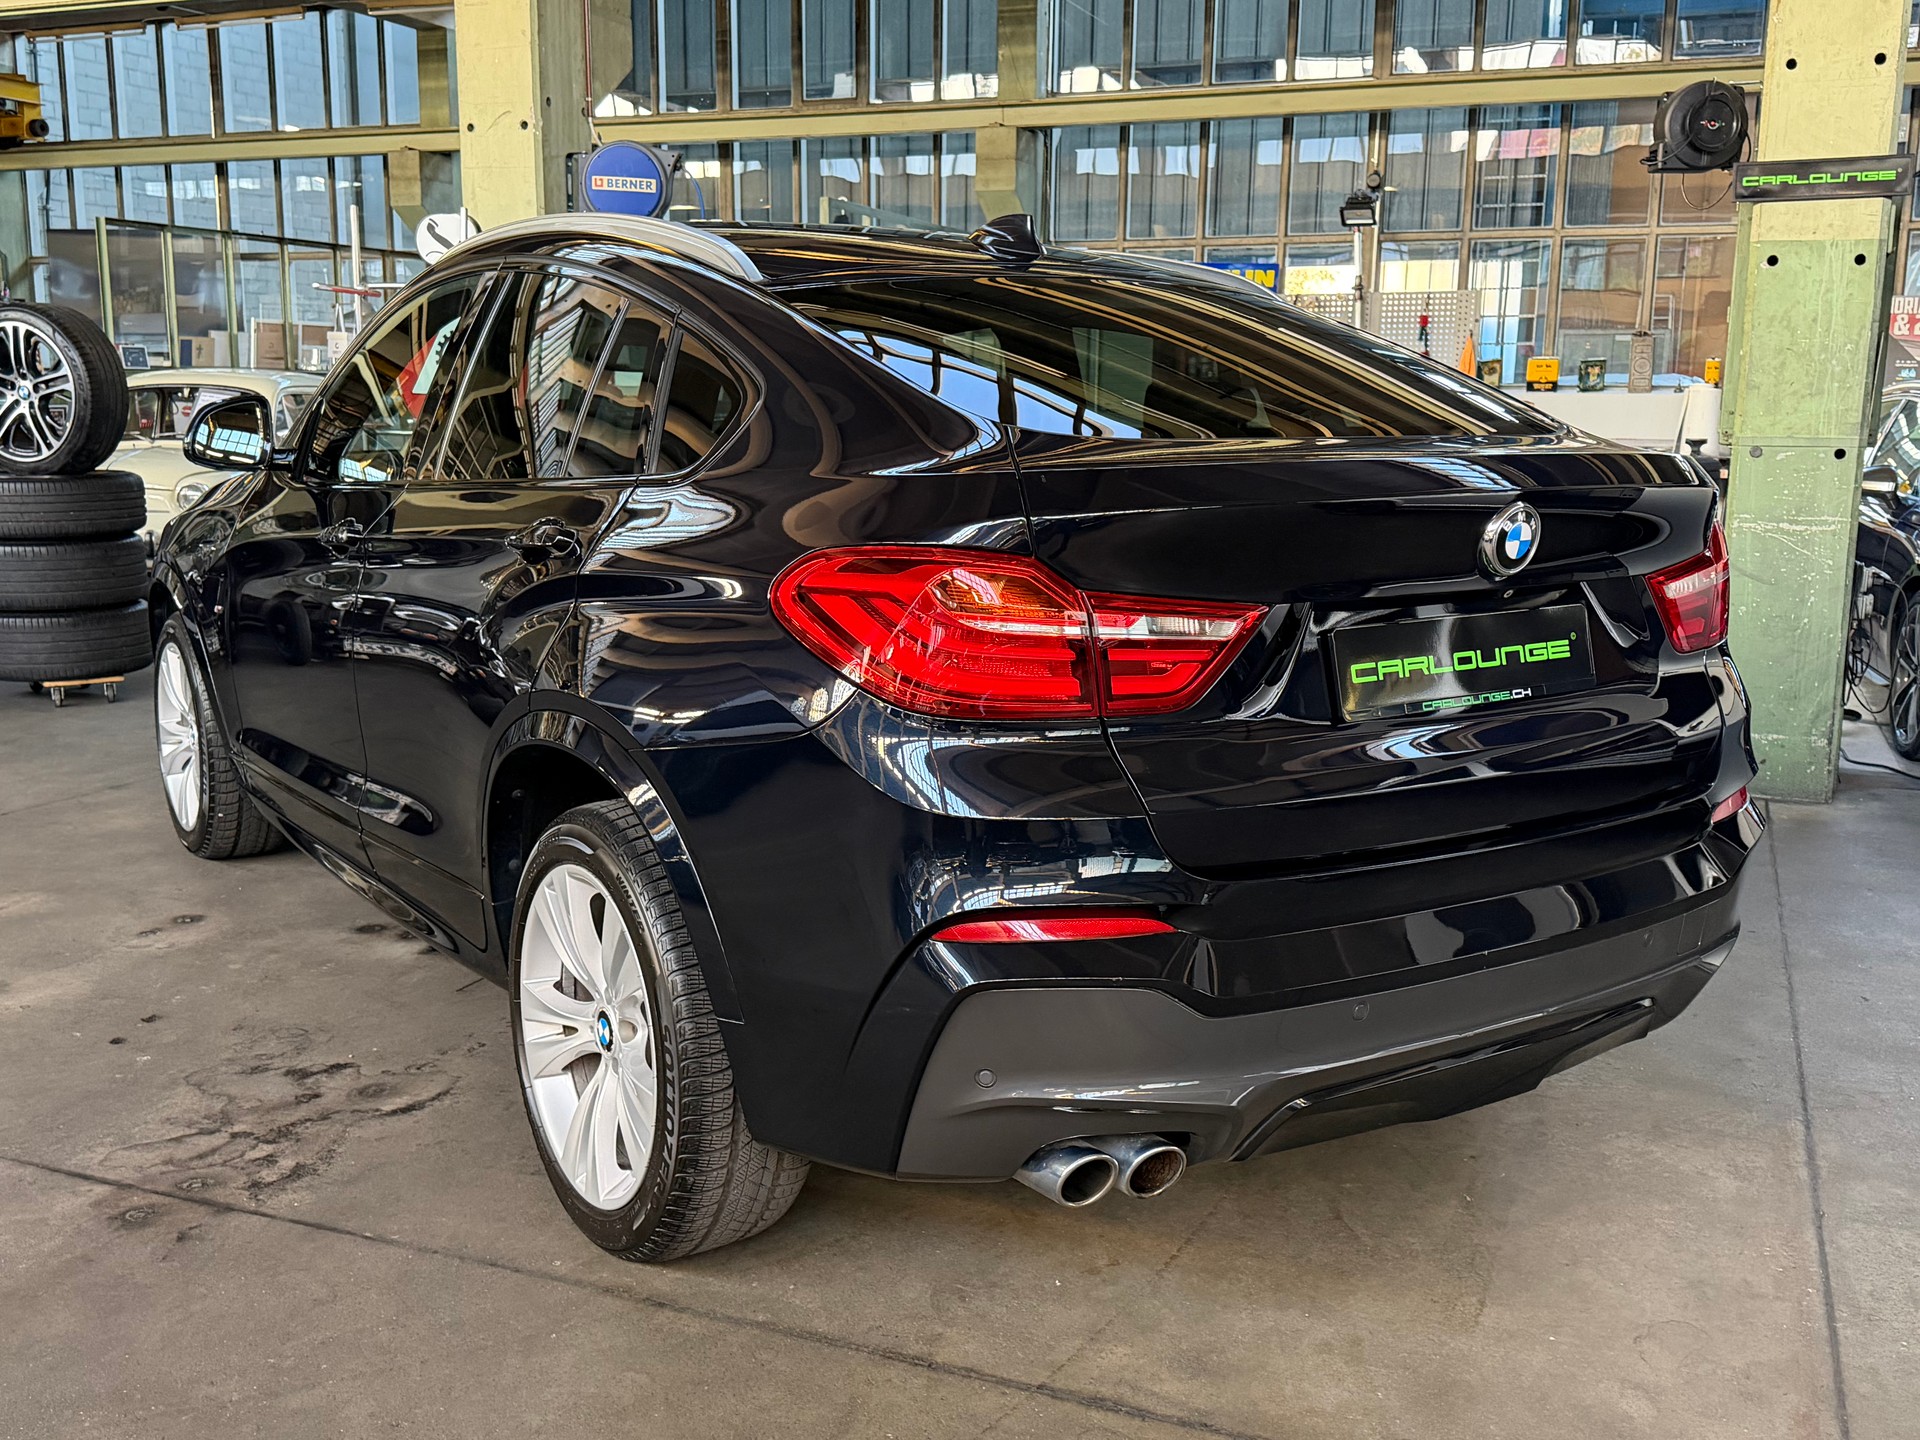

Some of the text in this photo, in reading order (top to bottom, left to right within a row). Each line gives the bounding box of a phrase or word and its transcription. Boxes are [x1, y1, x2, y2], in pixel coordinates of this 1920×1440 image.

[606, 178, 653, 190] BERNER
[1422, 688, 1532, 711] CARLOUNGE.CH
[615, 872, 645, 934] WINTER
